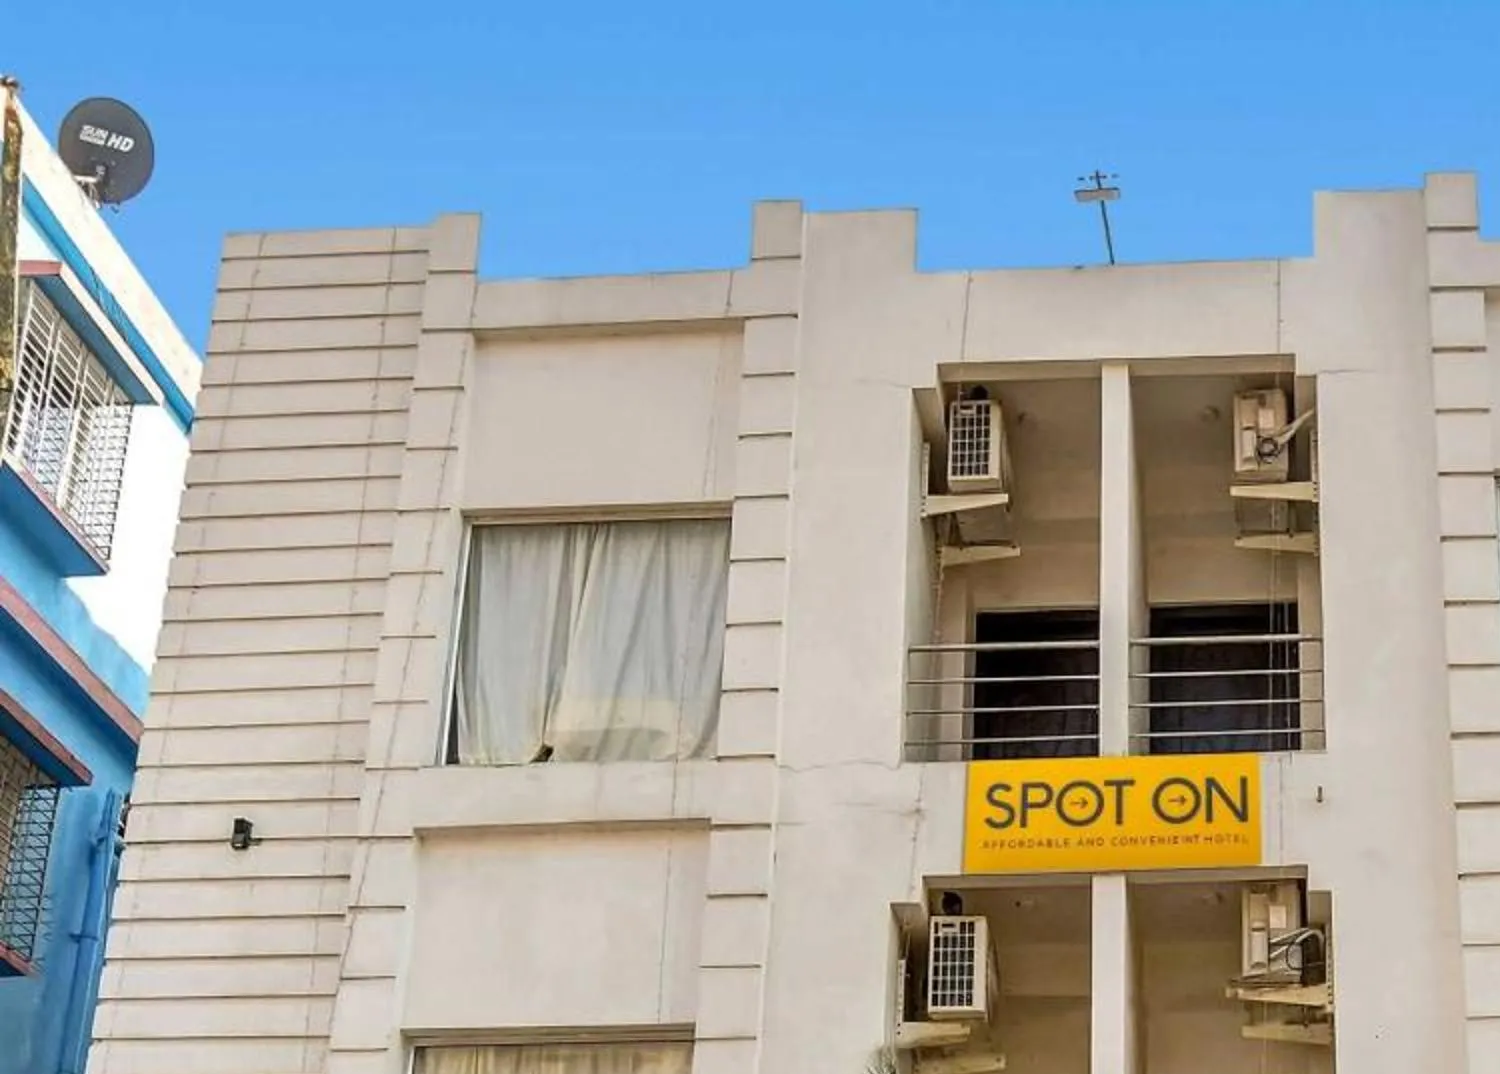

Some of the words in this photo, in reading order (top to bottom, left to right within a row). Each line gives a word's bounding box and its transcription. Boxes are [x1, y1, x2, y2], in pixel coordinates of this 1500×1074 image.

[106, 132, 135, 152] HD
[984, 780, 1136, 830] SPOT
[1151, 776, 1250, 825] ON
[982, 838, 1071, 850] AFFORDABLE
[1076, 837, 1105, 847] AND
[1203, 833, 1250, 845] HOTEL
